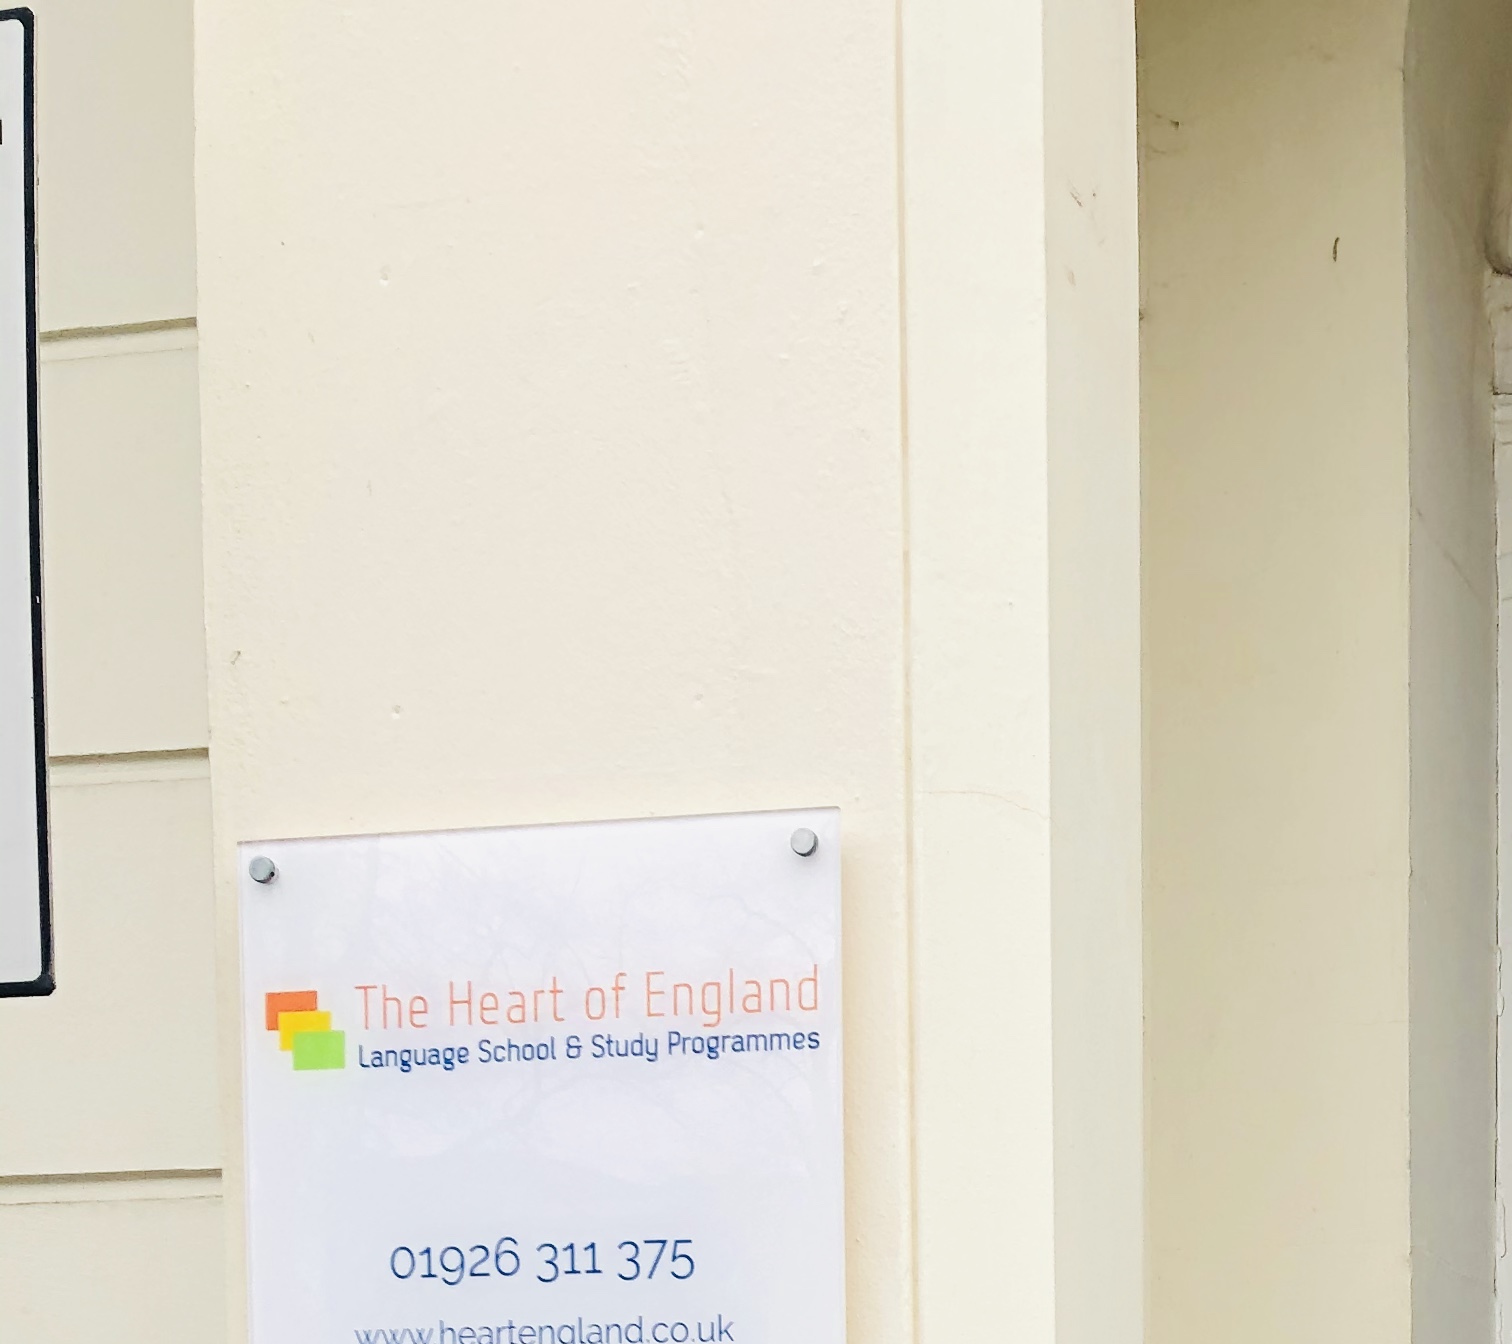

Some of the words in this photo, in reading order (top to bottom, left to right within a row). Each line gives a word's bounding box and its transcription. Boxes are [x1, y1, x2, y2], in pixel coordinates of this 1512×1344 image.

[355, 984, 428, 1029] The
[449, 977, 563, 1024] Heart
[585, 972, 626, 1021] of
[645, 964, 818, 1027] England
[358, 1044, 470, 1074] Language
[478, 1039, 556, 1063] School
[564, 1036, 583, 1059] &
[591, 1035, 658, 1062] Study
[668, 1031, 820, 1060] Programmes
[390, 1236, 520, 1286] 01926
[536, 1242, 603, 1283] 311
[617, 1239, 695, 1281] 375
